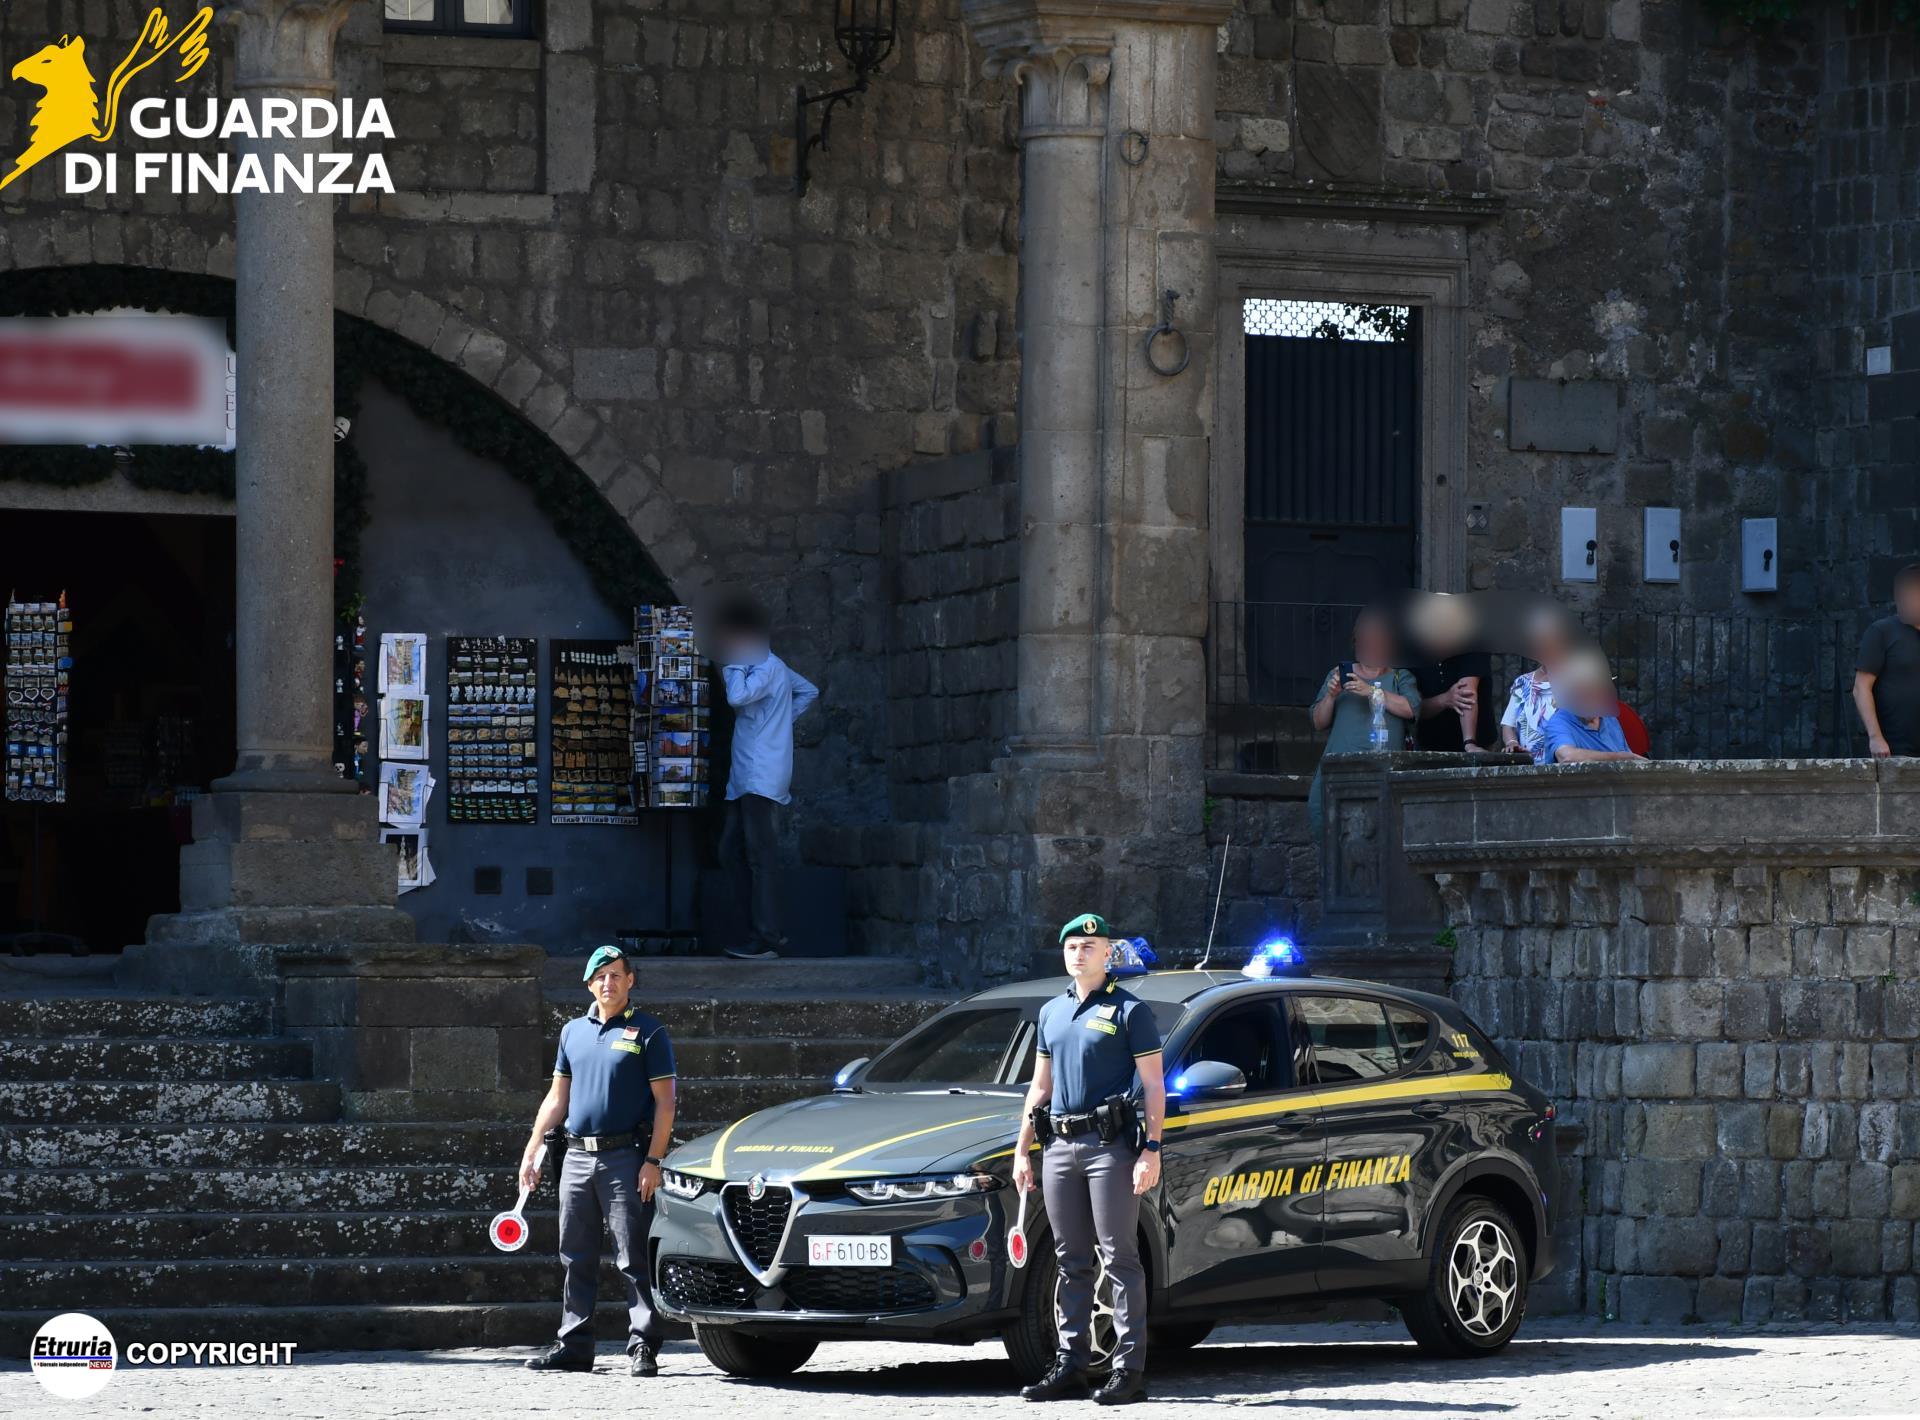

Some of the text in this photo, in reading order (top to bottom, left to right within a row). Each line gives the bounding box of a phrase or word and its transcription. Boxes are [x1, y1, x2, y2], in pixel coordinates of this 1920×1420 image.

[1451, 1033, 1470, 1048] 117
[787, 1145, 835, 1154] FINANZA
[1202, 1154, 1412, 1206] GUARDIA di FINANZA
